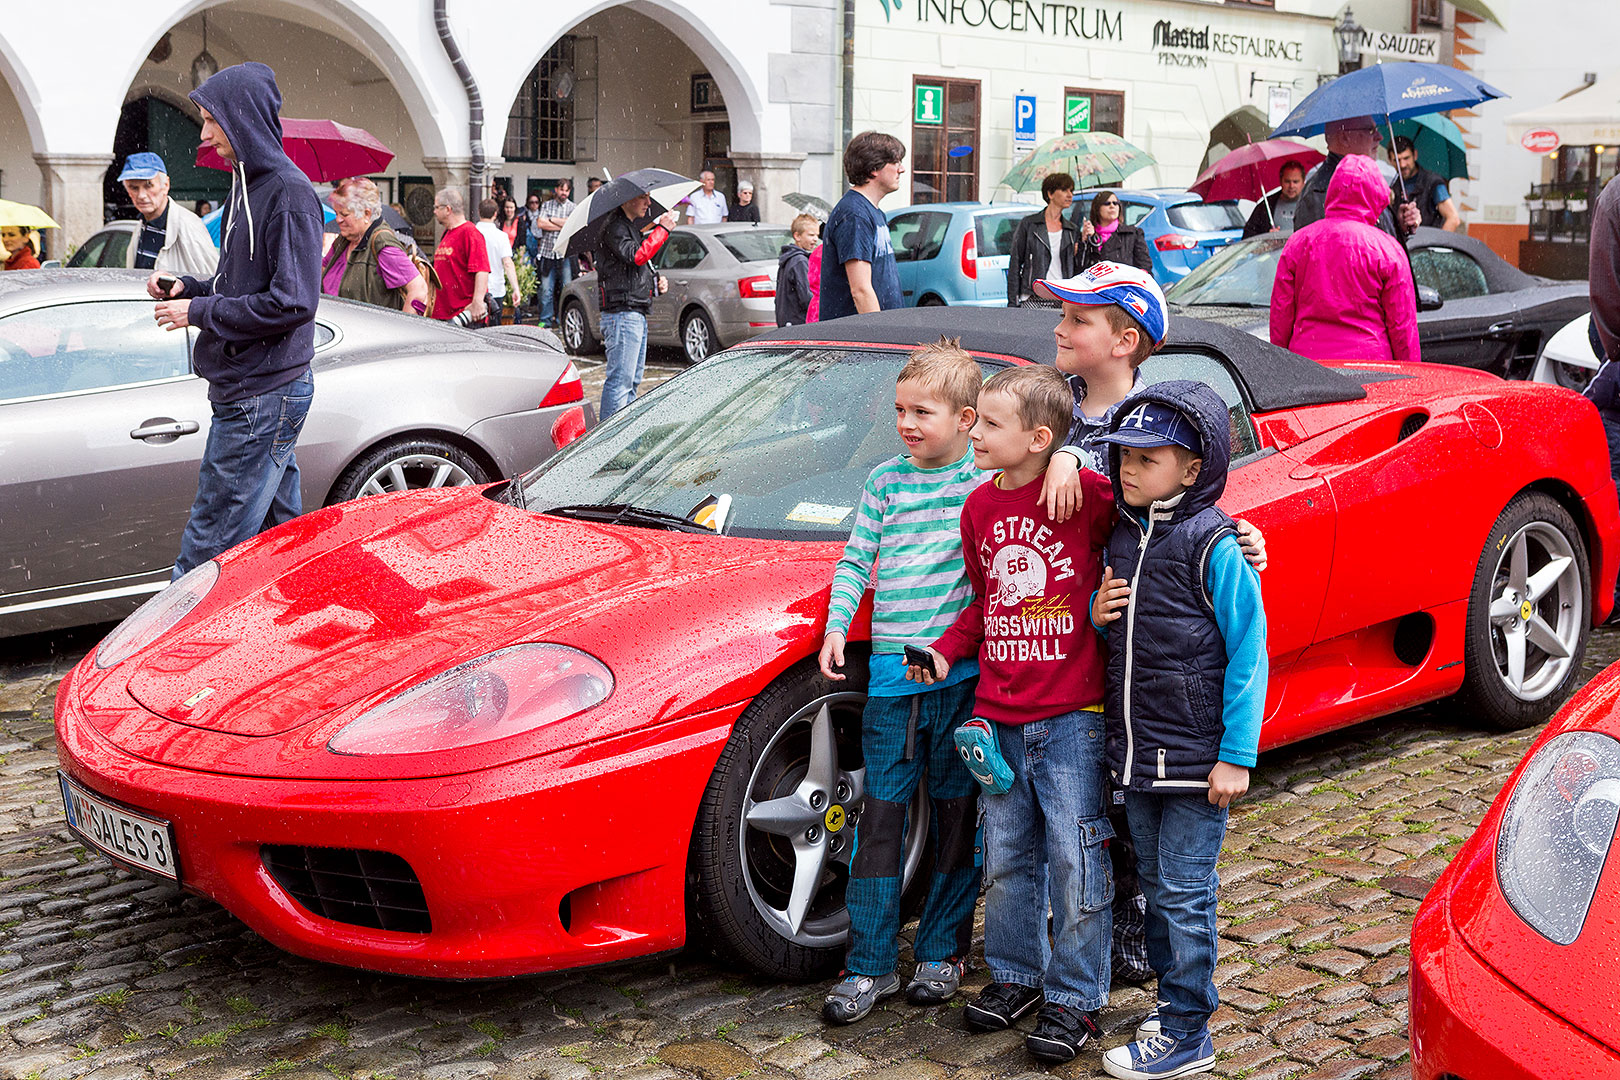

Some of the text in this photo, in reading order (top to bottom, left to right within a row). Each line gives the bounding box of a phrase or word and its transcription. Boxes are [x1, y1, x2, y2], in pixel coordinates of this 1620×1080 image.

[917, 0, 1123, 41] INFOCENTRUM
[1213, 33, 1303, 62] RESTAURACE
[1378, 32, 1435, 57] SAUDEK
[1158, 52, 1208, 68] PENZION
[1018, 99, 1033, 129] P
[993, 516, 1076, 582] STREAM
[1007, 557, 1029, 576] 56
[984, 638, 1068, 662] OOTBALL
[90, 804, 150, 861] SALES
[151, 829, 168, 867] 3
